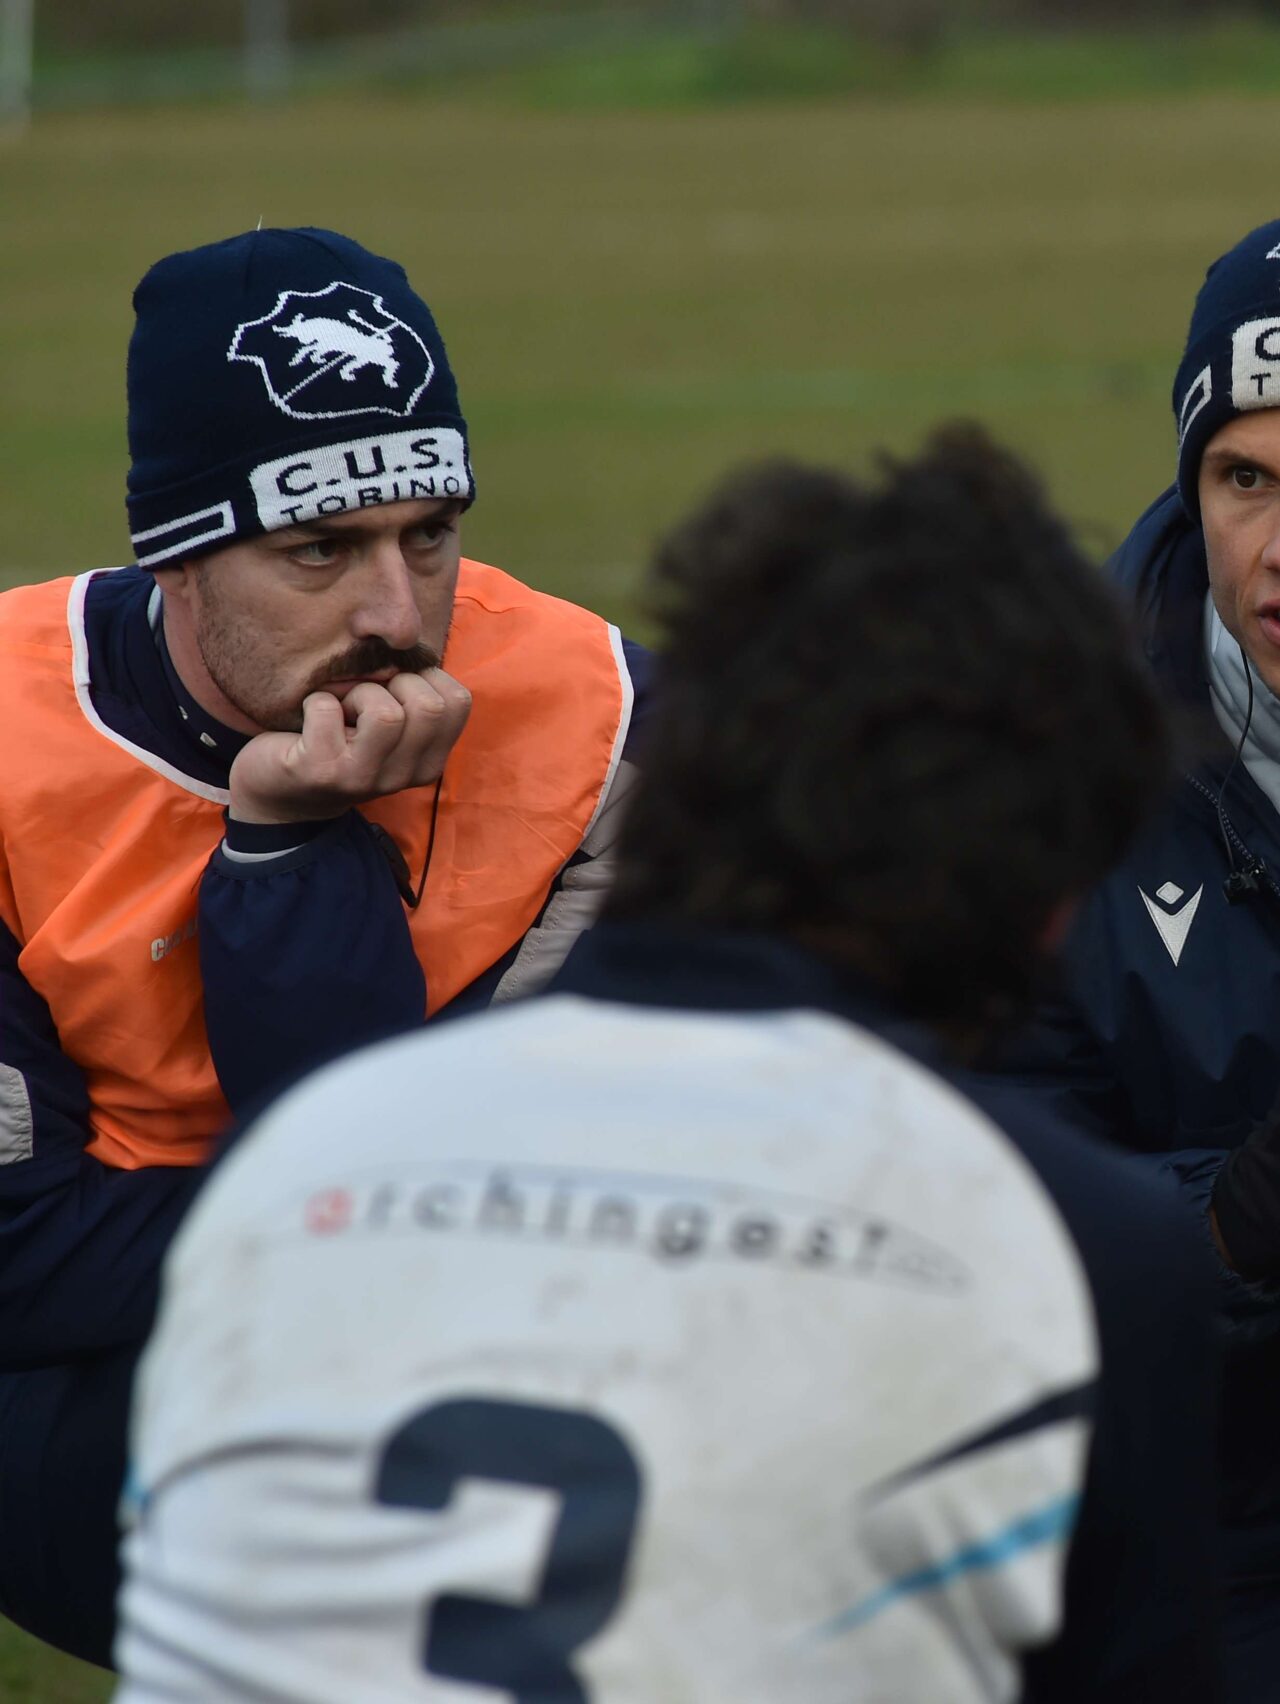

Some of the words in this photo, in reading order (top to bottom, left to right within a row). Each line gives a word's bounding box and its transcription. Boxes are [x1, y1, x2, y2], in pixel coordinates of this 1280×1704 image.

[276, 437, 453, 496] C.U.S.
[304, 1169, 890, 1268] archingest
[371, 1393, 646, 1704] 3
